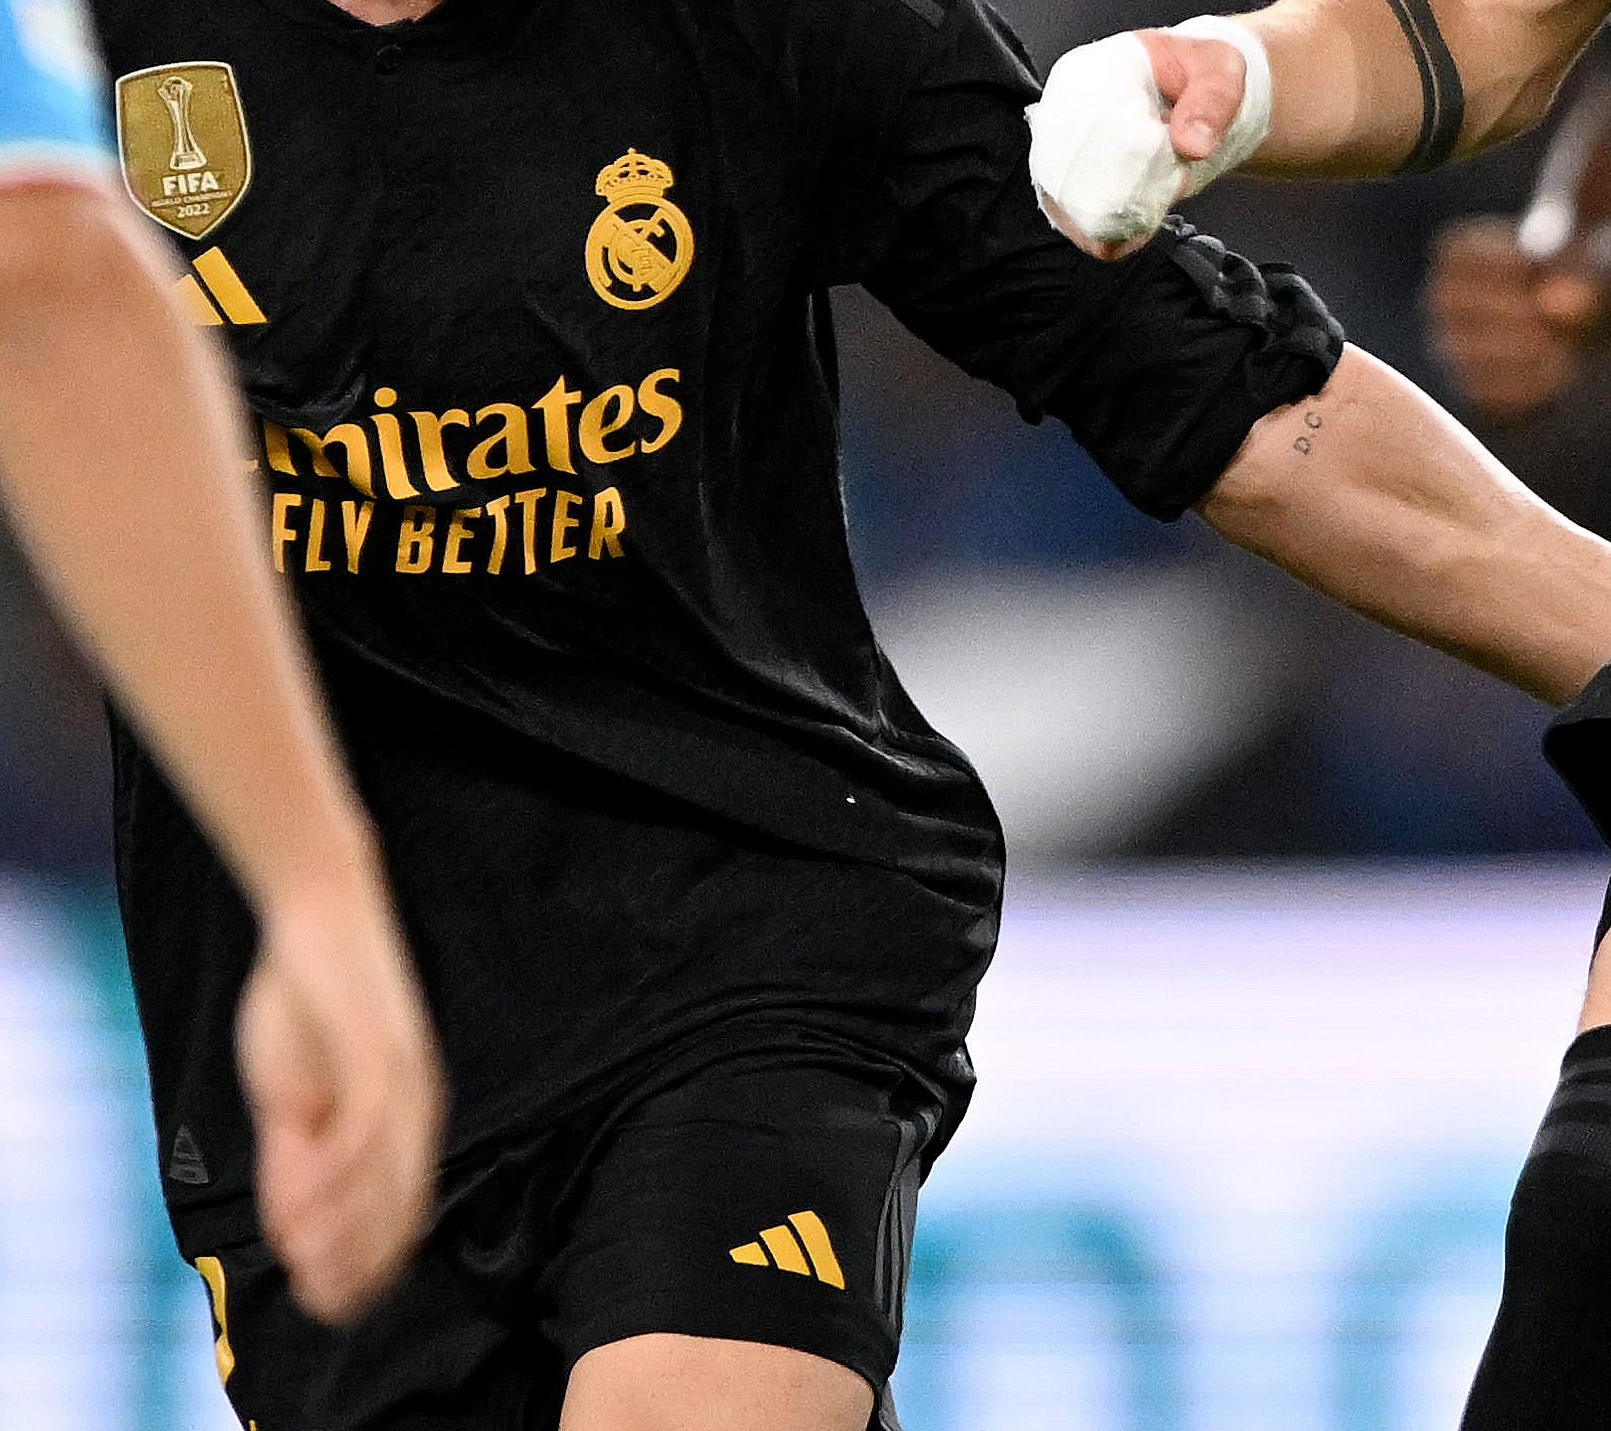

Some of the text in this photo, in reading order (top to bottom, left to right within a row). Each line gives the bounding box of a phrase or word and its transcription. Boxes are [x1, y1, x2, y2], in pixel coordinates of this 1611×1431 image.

[162, 170, 219, 197] FIFA
[176, 202, 211, 219] 2022
[263, 367, 684, 501] mirates
[271, 485, 627, 576] FLY BETTER
